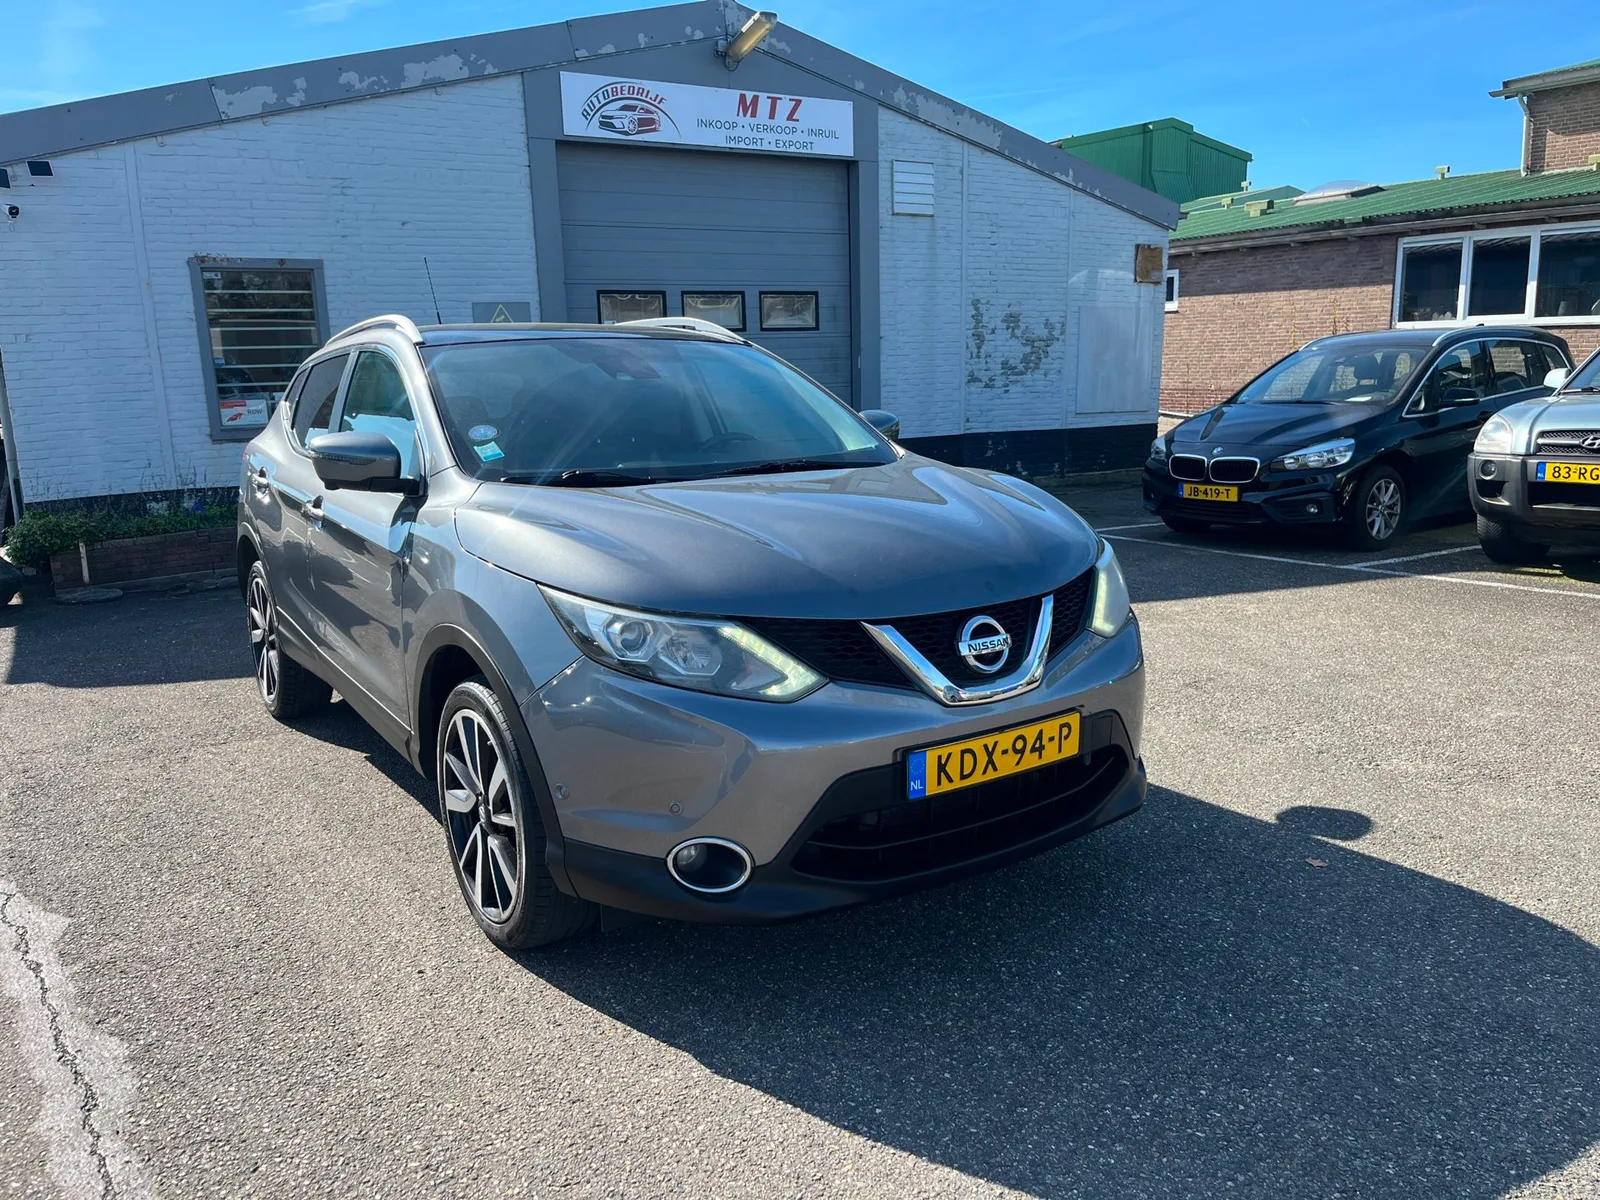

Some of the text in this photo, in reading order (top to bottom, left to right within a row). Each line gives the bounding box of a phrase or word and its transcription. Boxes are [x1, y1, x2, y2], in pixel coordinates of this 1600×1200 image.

[581, 85, 667, 121] AUTOBEDRIJF
[736, 93, 803, 122] MTZ
[697, 118, 839, 140] INKOOP VERKOOP INRUIL
[725, 135, 815, 151] IMPORT EXPORT
[1187, 486, 1231, 499] JB-419-T
[967, 636, 1009, 653] NISSAN
[936, 721, 1072, 787] KDX-94-P
[910, 779, 924, 791] NL
